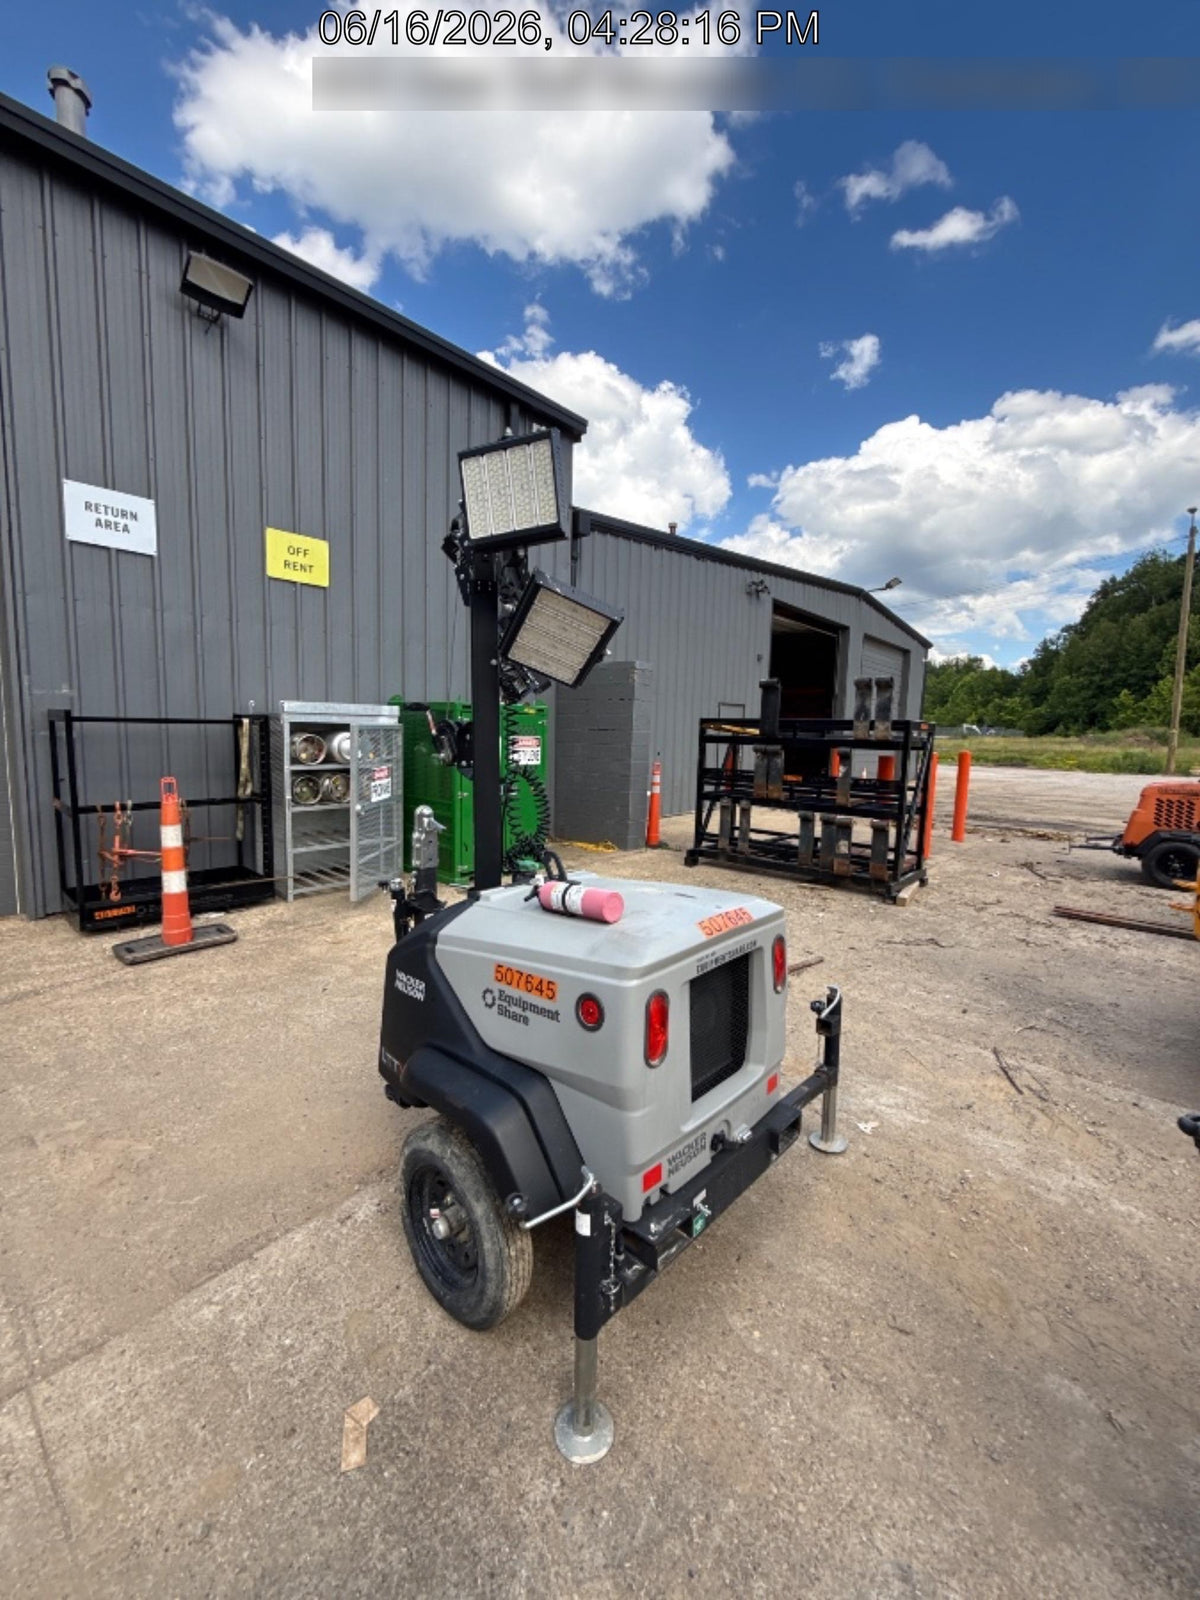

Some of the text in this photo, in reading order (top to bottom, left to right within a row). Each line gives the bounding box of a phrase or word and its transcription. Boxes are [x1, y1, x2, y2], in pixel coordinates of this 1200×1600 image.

[84, 501, 139, 522] RETURN
[95, 518, 130, 534] AREA
[287, 545, 310, 558] OFF
[283, 559, 315, 574] RENT
[698, 907, 753, 936] 507645
[495, 964, 556, 1000] 507645
[497, 1004, 530, 1026] Share
[498, 988, 561, 1023] Equipment
